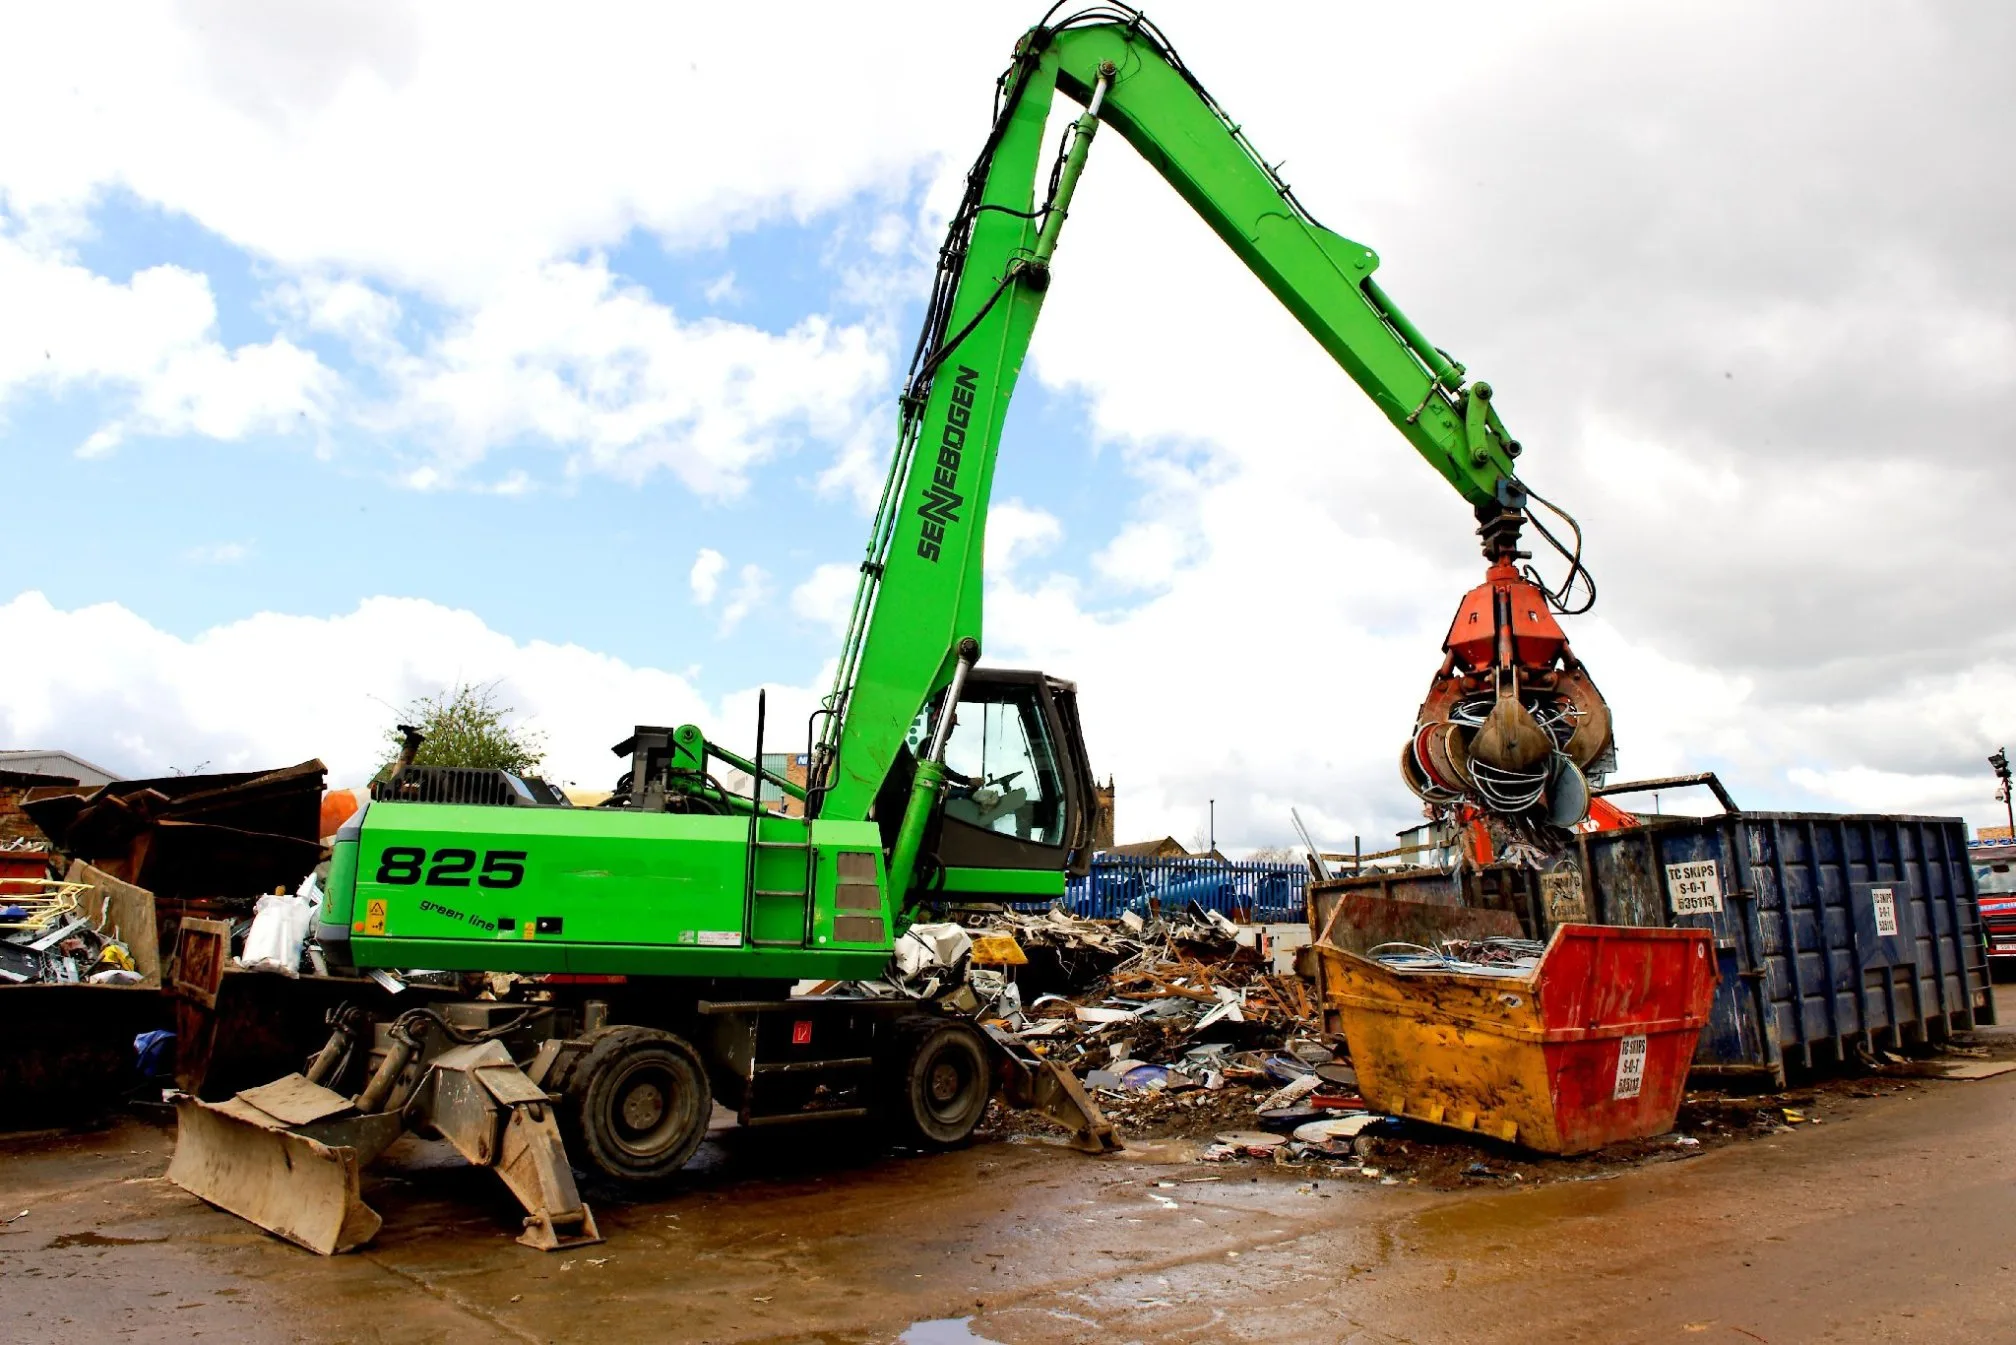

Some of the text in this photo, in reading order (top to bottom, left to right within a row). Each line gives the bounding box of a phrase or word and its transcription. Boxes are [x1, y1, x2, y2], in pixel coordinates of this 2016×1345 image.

[917, 364, 979, 563] SENNEBOGEN
[376, 846, 528, 889] 825
[1668, 865, 1714, 880] TC SKIPS
[1677, 895, 1715, 910] 535113
[419, 900, 496, 931] green line
[1622, 1039, 1646, 1055] TC SKIPS
